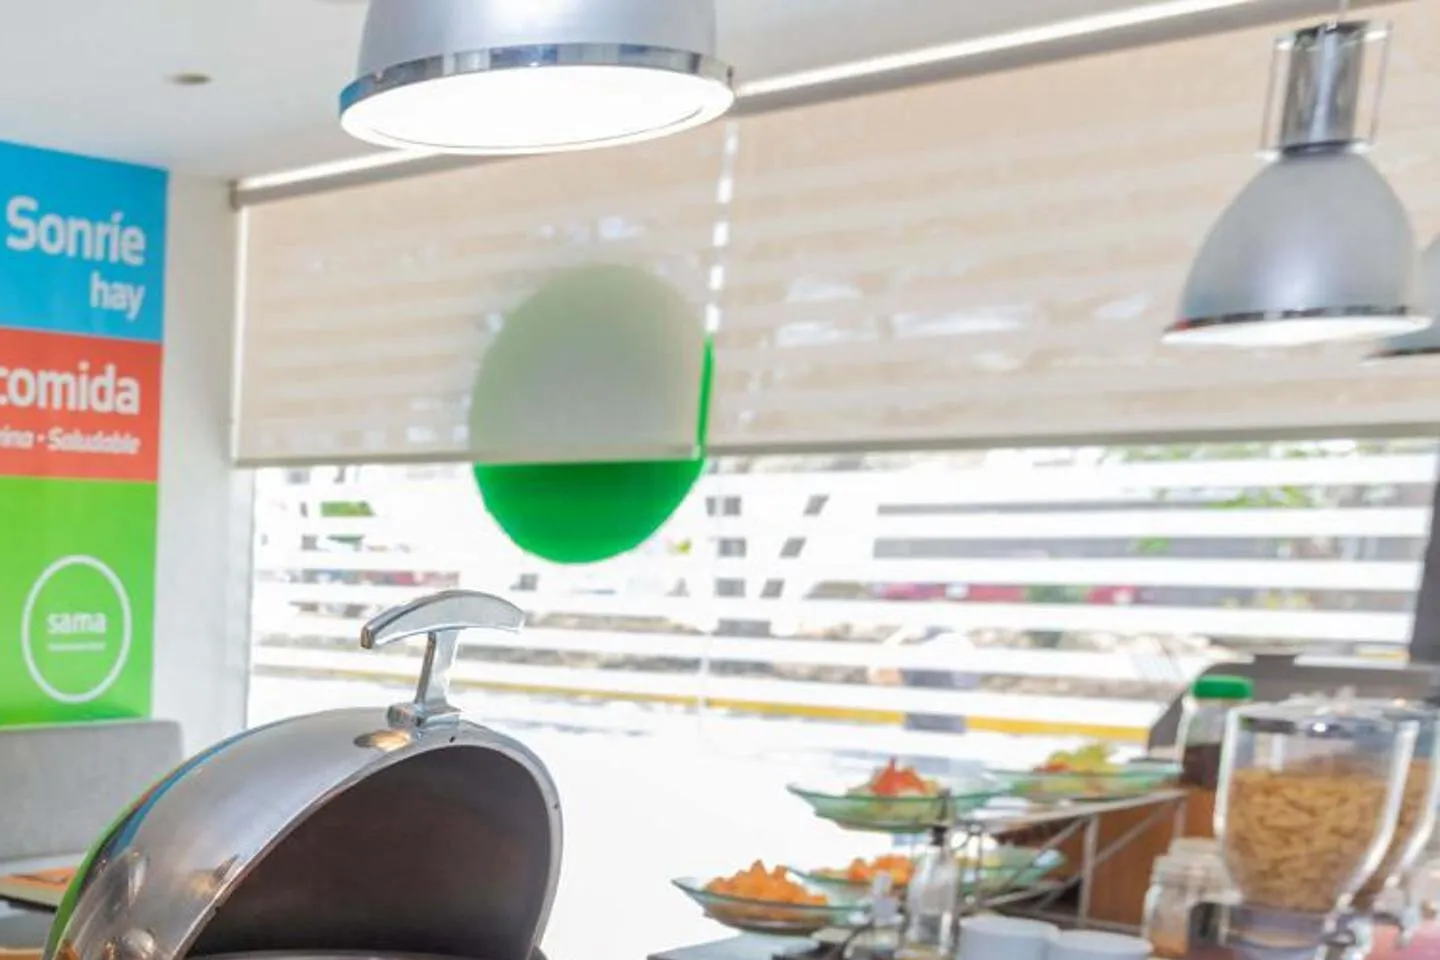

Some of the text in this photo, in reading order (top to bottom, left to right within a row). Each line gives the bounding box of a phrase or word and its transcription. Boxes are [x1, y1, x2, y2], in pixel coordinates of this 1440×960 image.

[6, 195, 146, 266] Sonríe
[90, 271, 145, 321] hay
[47, 612, 107, 634] sama
